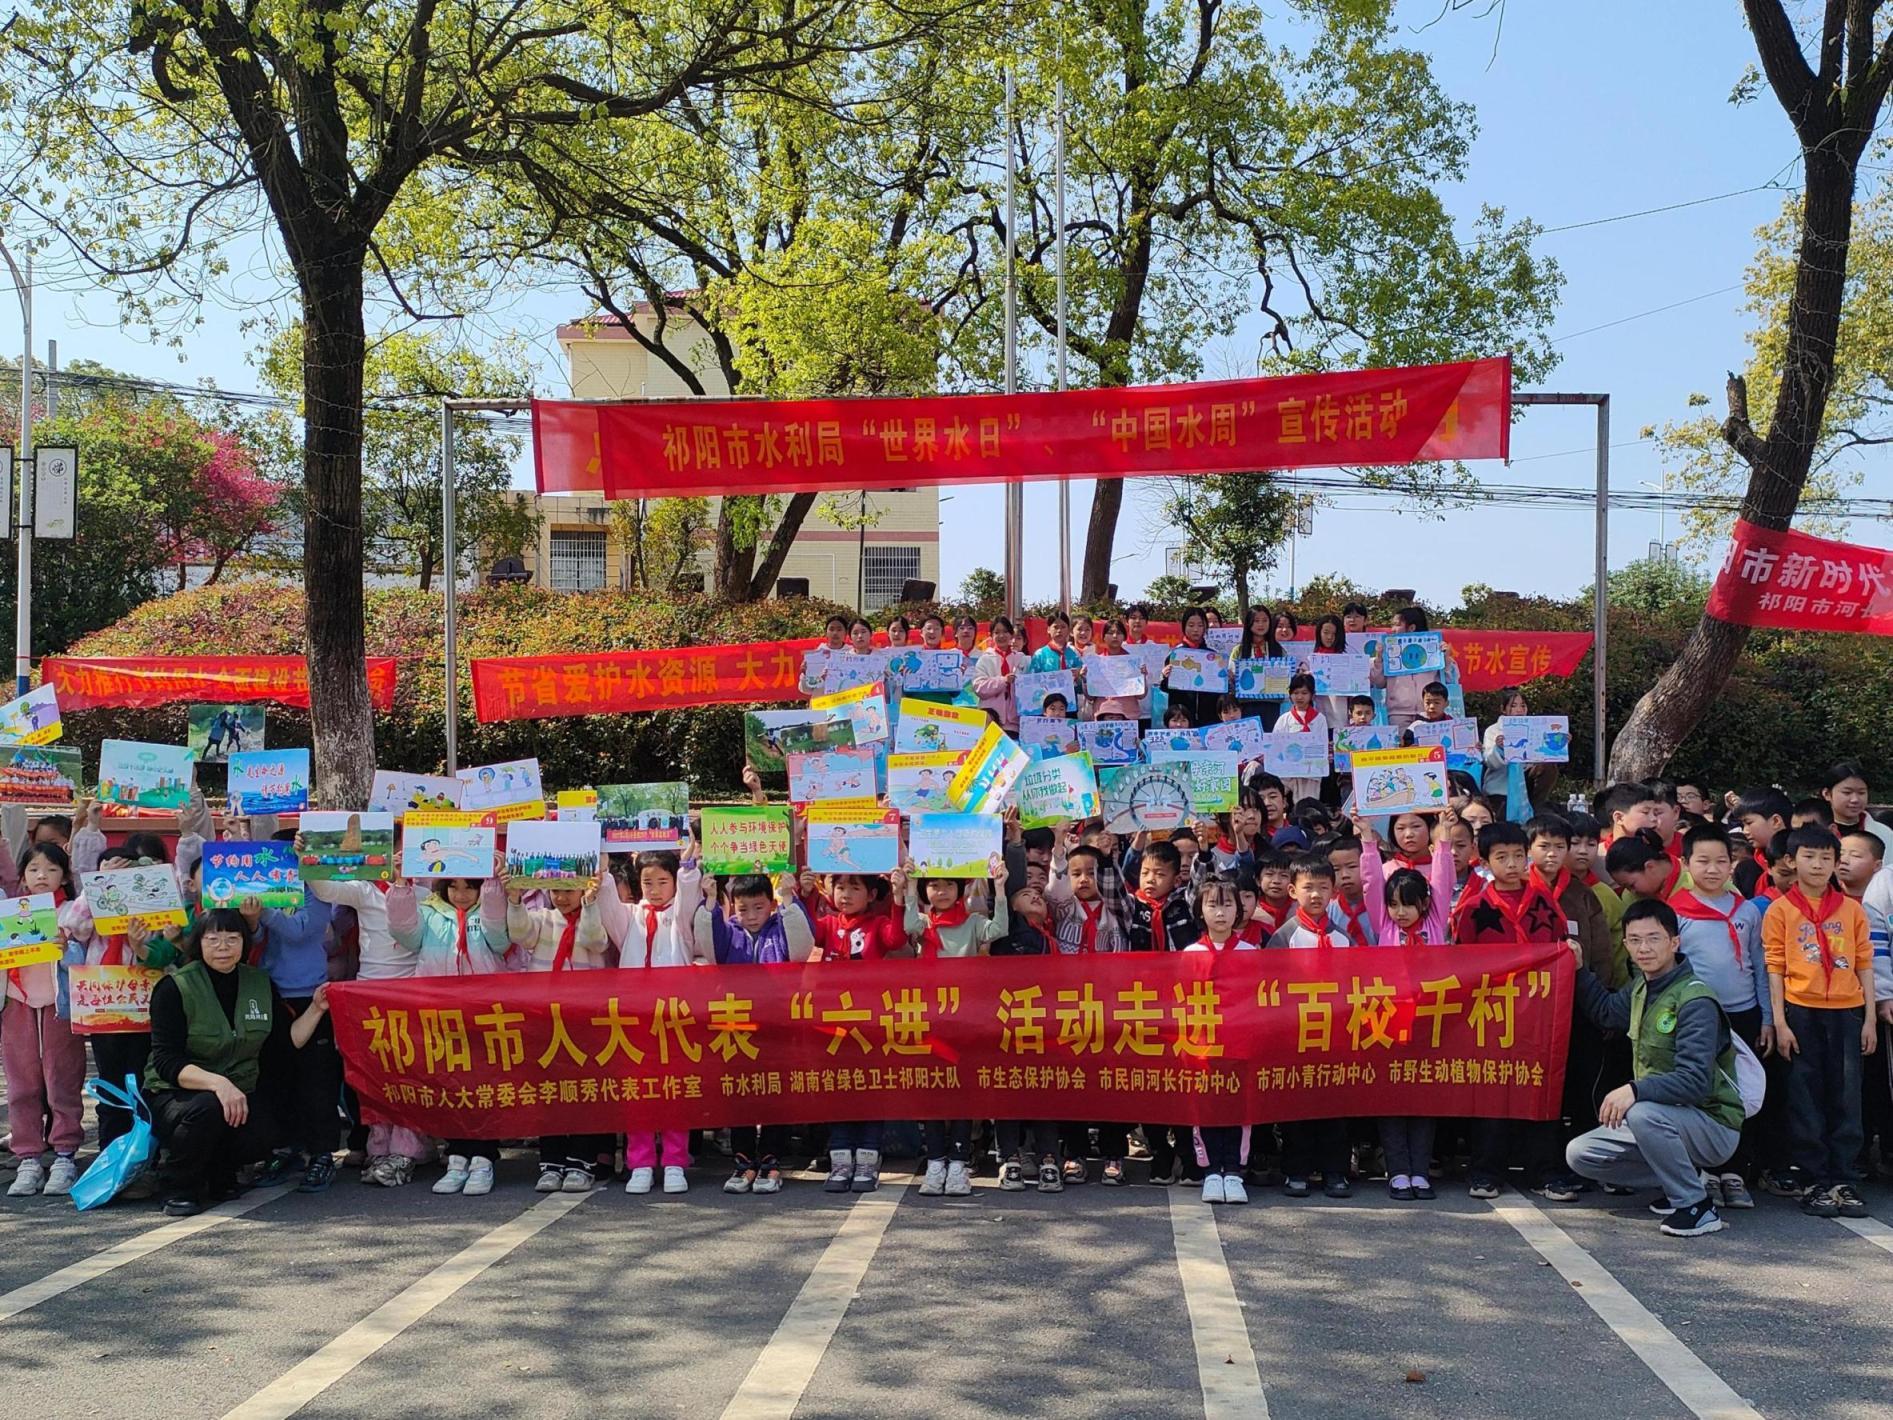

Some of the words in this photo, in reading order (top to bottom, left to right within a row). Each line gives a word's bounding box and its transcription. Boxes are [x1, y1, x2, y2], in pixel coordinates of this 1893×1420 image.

[497, 655, 719, 709] 节省爱护水资源
[1433, 751, 1441, 760] 5
[485, 816, 494, 825] 9
[888, 813, 897, 822] 7
[710, 821, 788, 835] 人人参与环境保护
[710, 840, 787, 854] 个个争当绿色天使
[384, 1075, 704, 1110] 祁阳市人大常委会李顺秀代表工作室
[721, 1068, 782, 1096] 市水利局
[789, 1066, 961, 1094] 湖南省绿色卫士祁阳大队
[978, 1066, 1087, 1091] 市生态保护协会
[1098, 1067, 1241, 1095] 市民间河长行动中心
[1257, 1065, 1376, 1092] 市河小青行动中心
[1388, 1058, 1545, 1088] 市野生动植物保护协会
